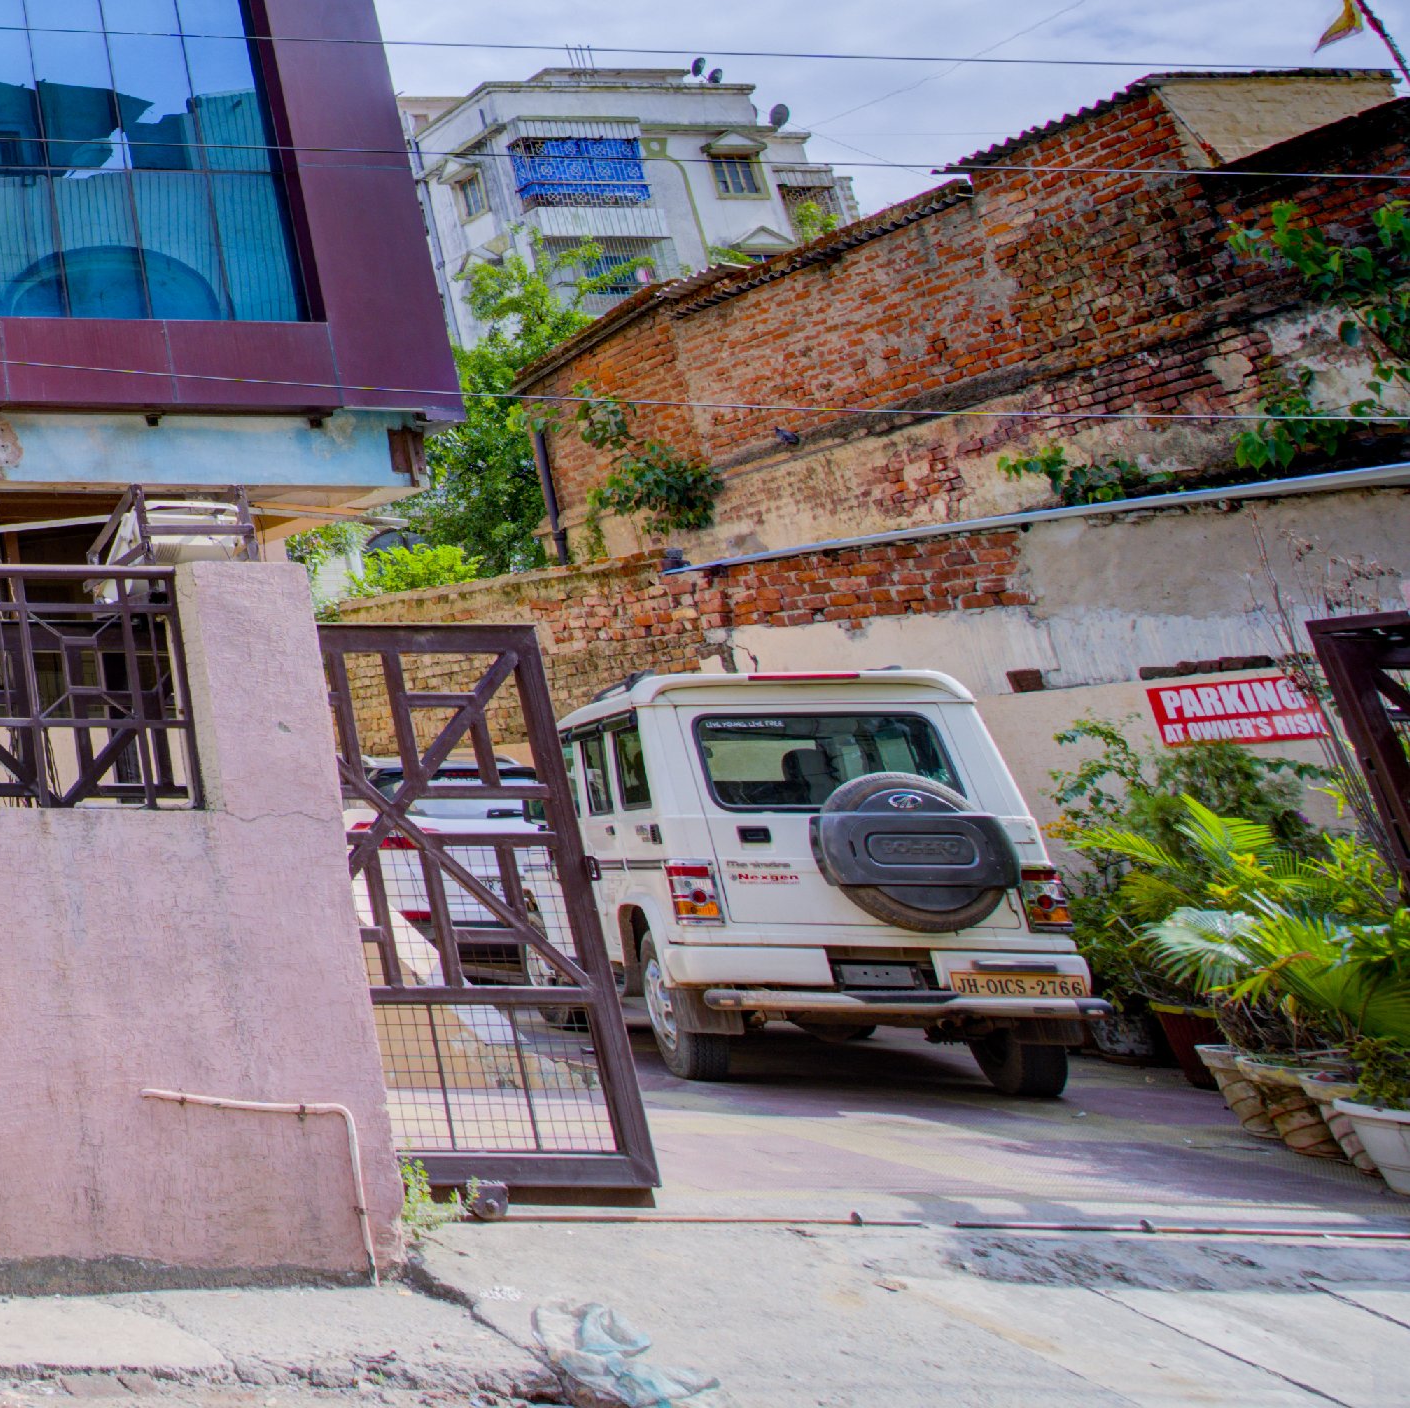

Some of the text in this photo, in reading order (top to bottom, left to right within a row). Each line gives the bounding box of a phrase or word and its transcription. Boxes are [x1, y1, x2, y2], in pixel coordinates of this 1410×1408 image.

[1159, 679, 1308, 720] PARKING
[1162, 723, 1186, 743] AT
[1187, 715, 1274, 742] OWNER'S
[738, 873, 799, 882] Nexgen
